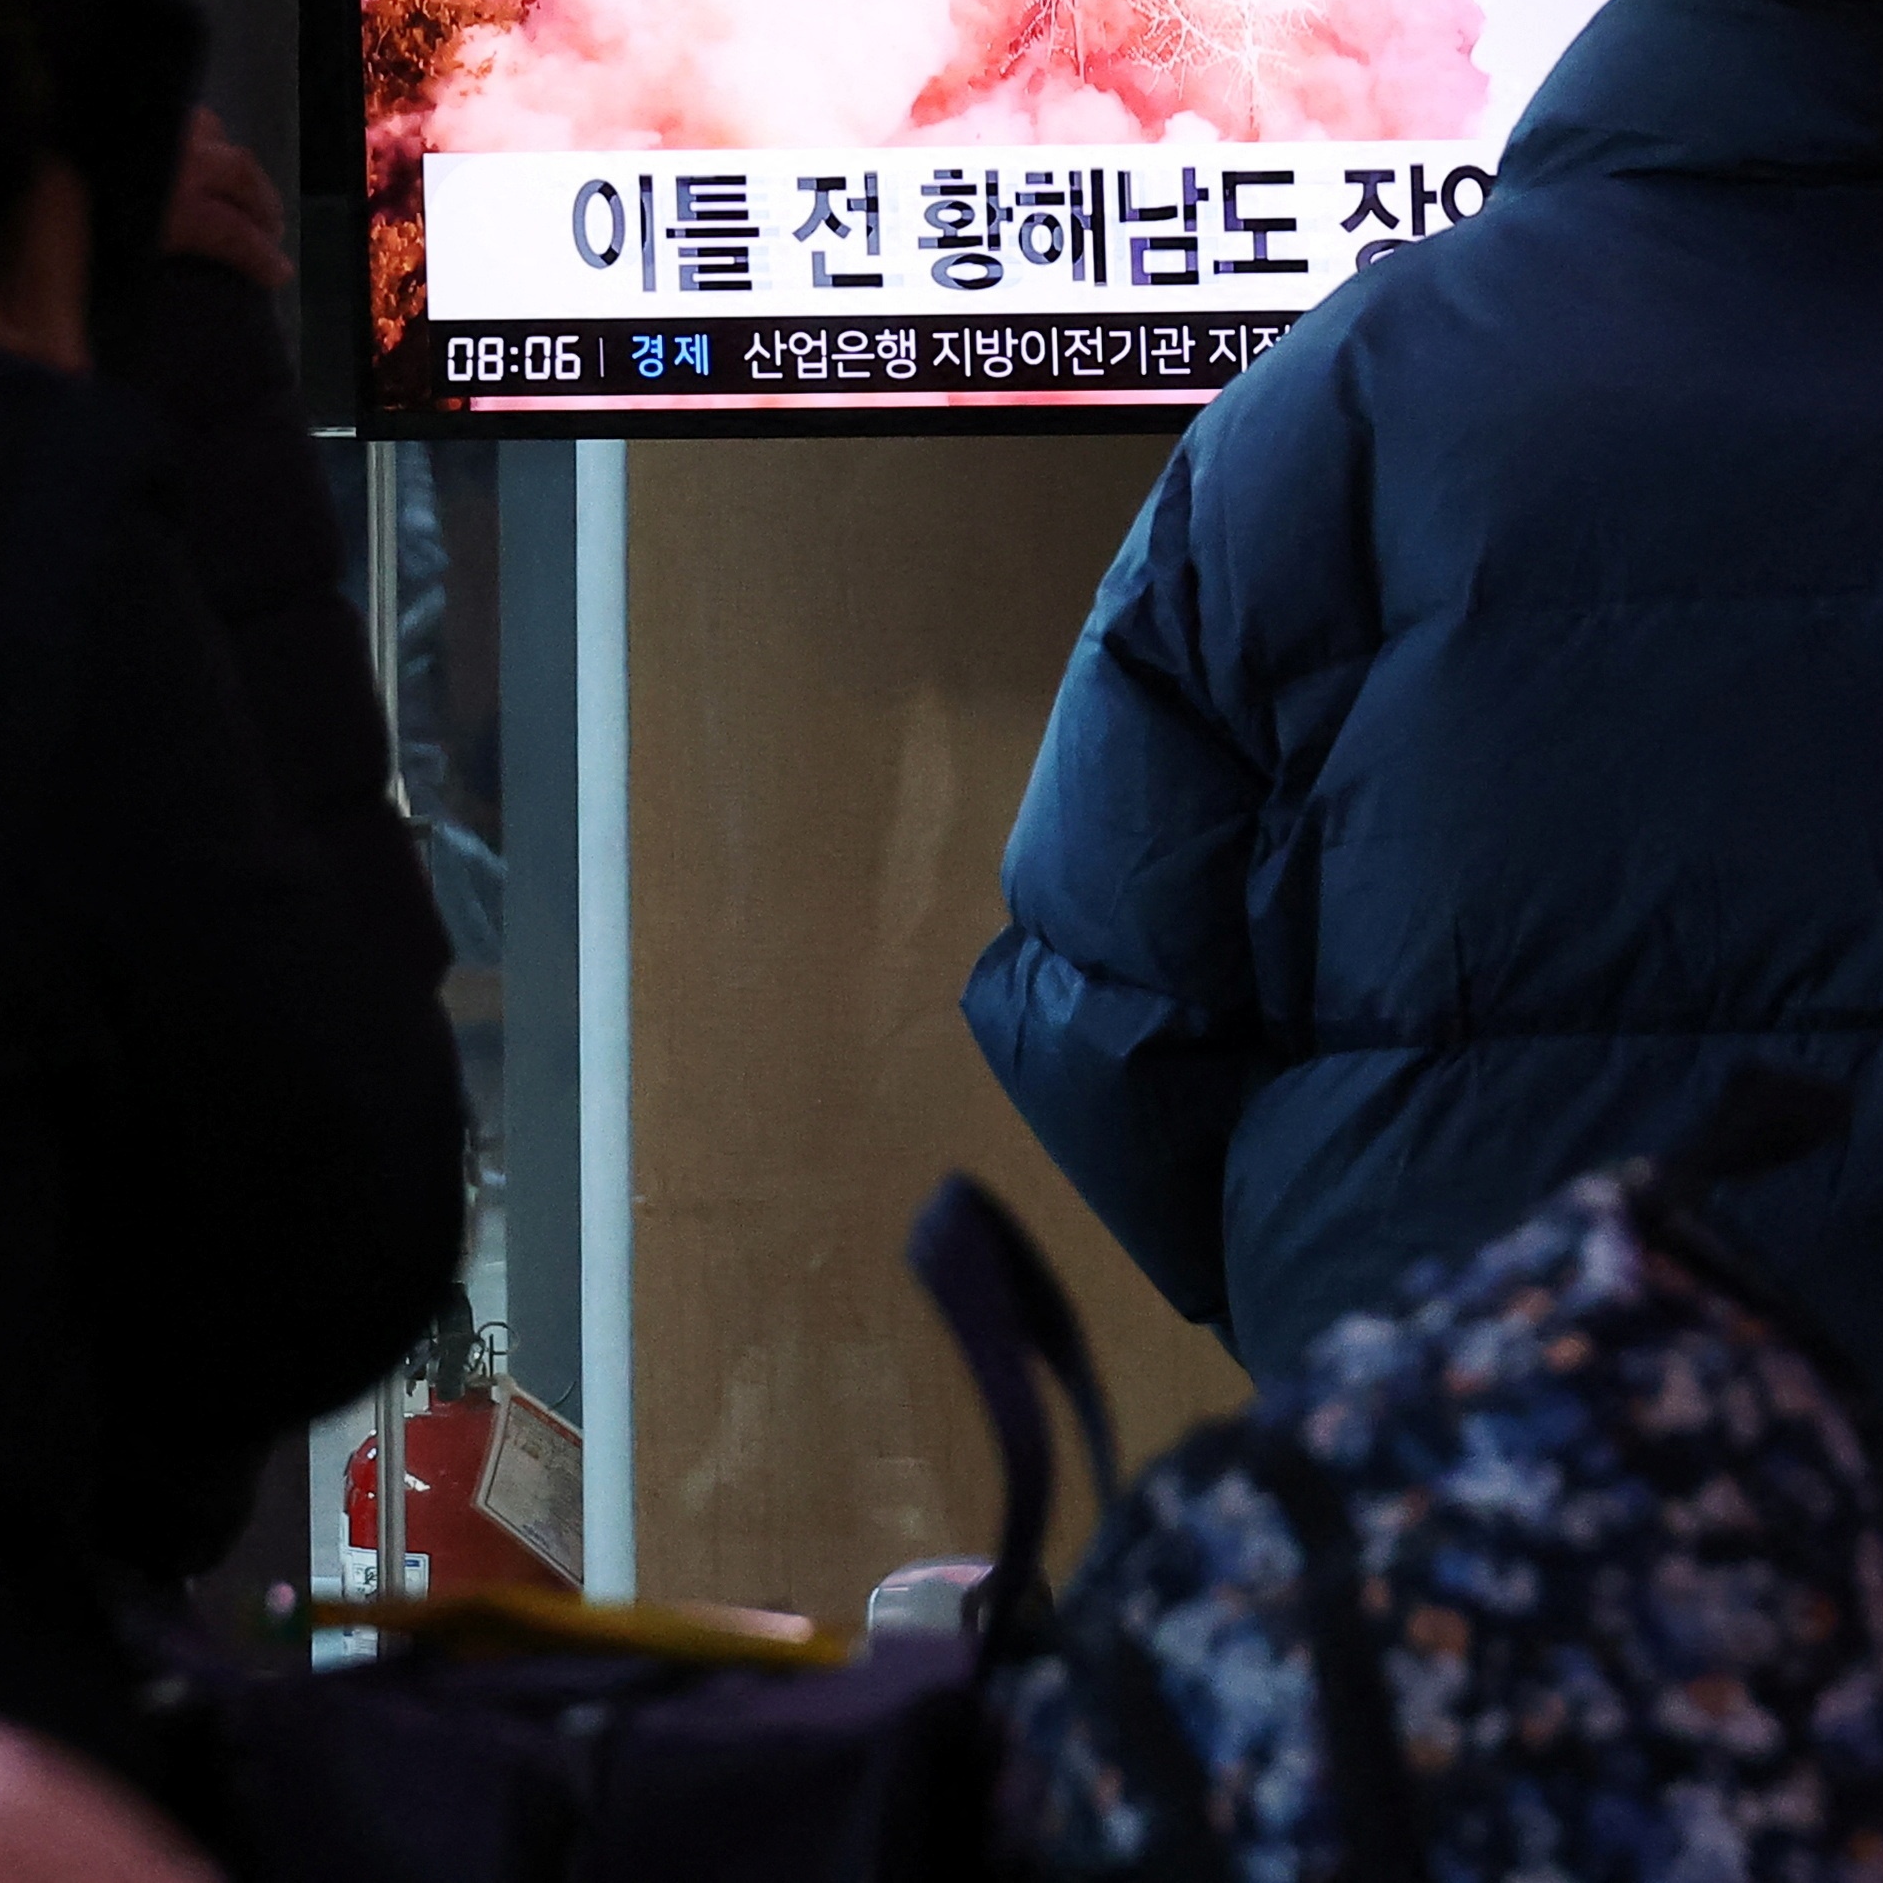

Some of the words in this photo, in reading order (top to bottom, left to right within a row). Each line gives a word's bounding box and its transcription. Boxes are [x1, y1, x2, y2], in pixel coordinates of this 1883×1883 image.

[571, 171, 761, 294] 이틀
[791, 169, 881, 290] 전
[917, 164, 1310, 294] 황해남도
[447, 335, 582, 382] 08:06
[630, 332, 712, 379] 경제
[743, 328, 917, 381] 산업은행
[931, 324, 1197, 379] 지방이전기관
